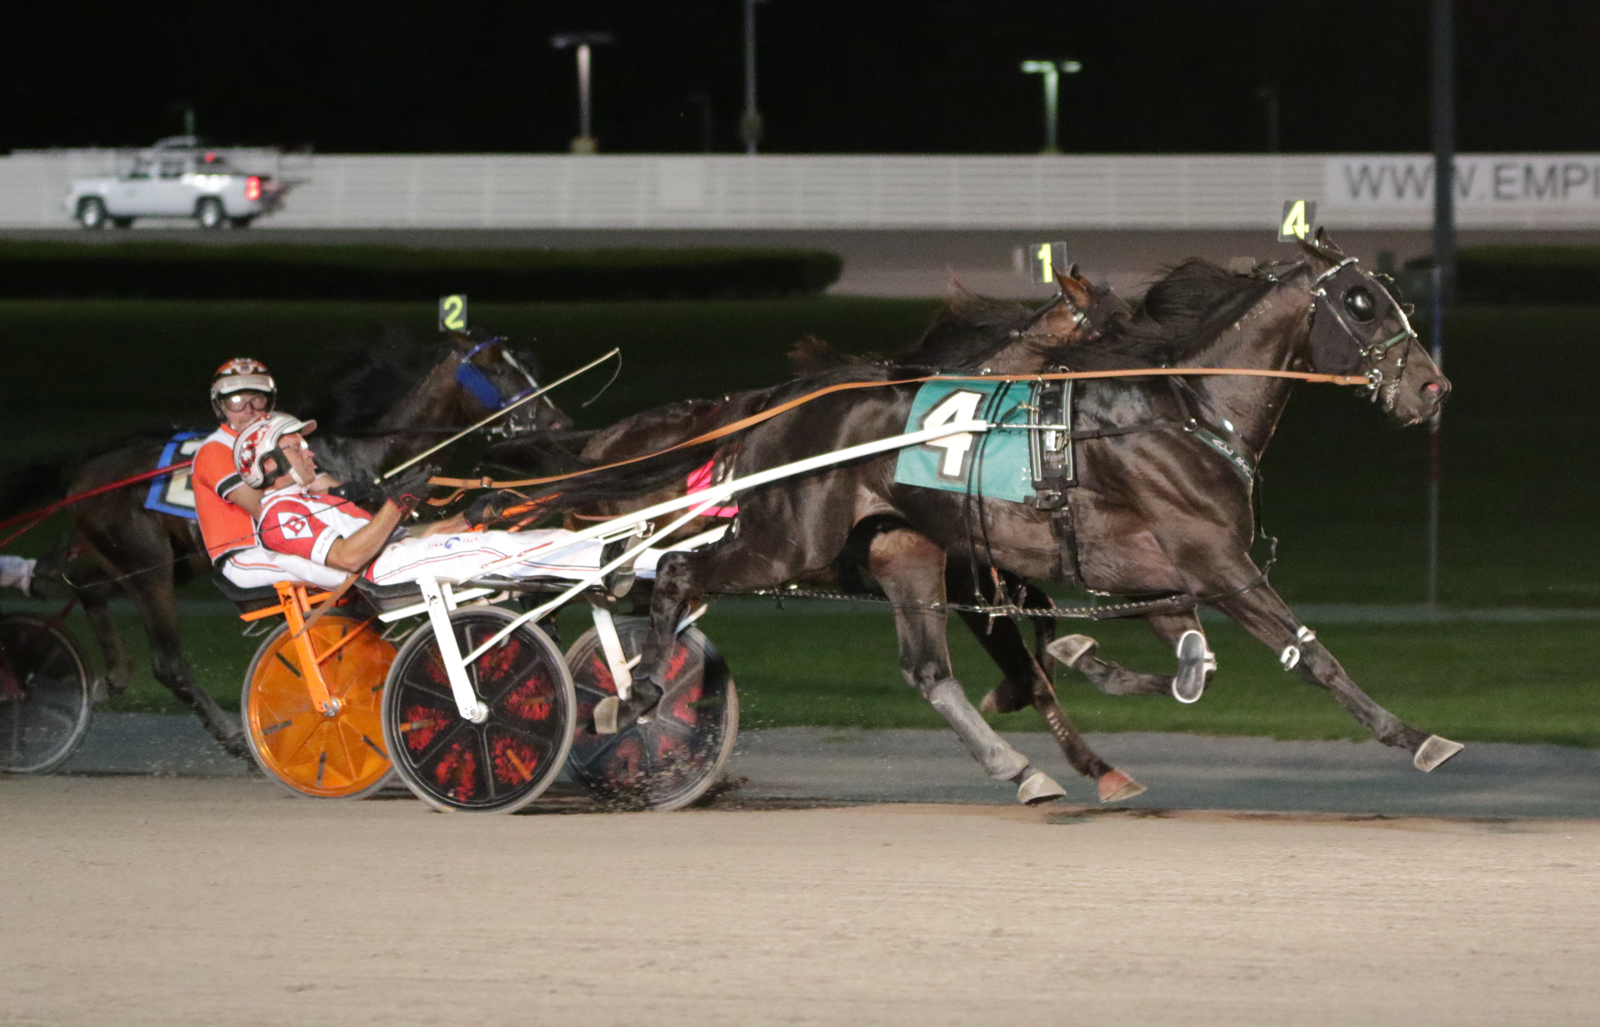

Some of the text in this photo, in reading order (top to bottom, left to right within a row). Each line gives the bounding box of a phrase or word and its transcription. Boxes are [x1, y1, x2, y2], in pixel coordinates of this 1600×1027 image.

[1282, 200, 1310, 239] 4
[1038, 243, 1053, 283] 1
[443, 295, 465, 330] 2
[920, 388, 986, 481] 4
[282, 515, 306, 537] B
